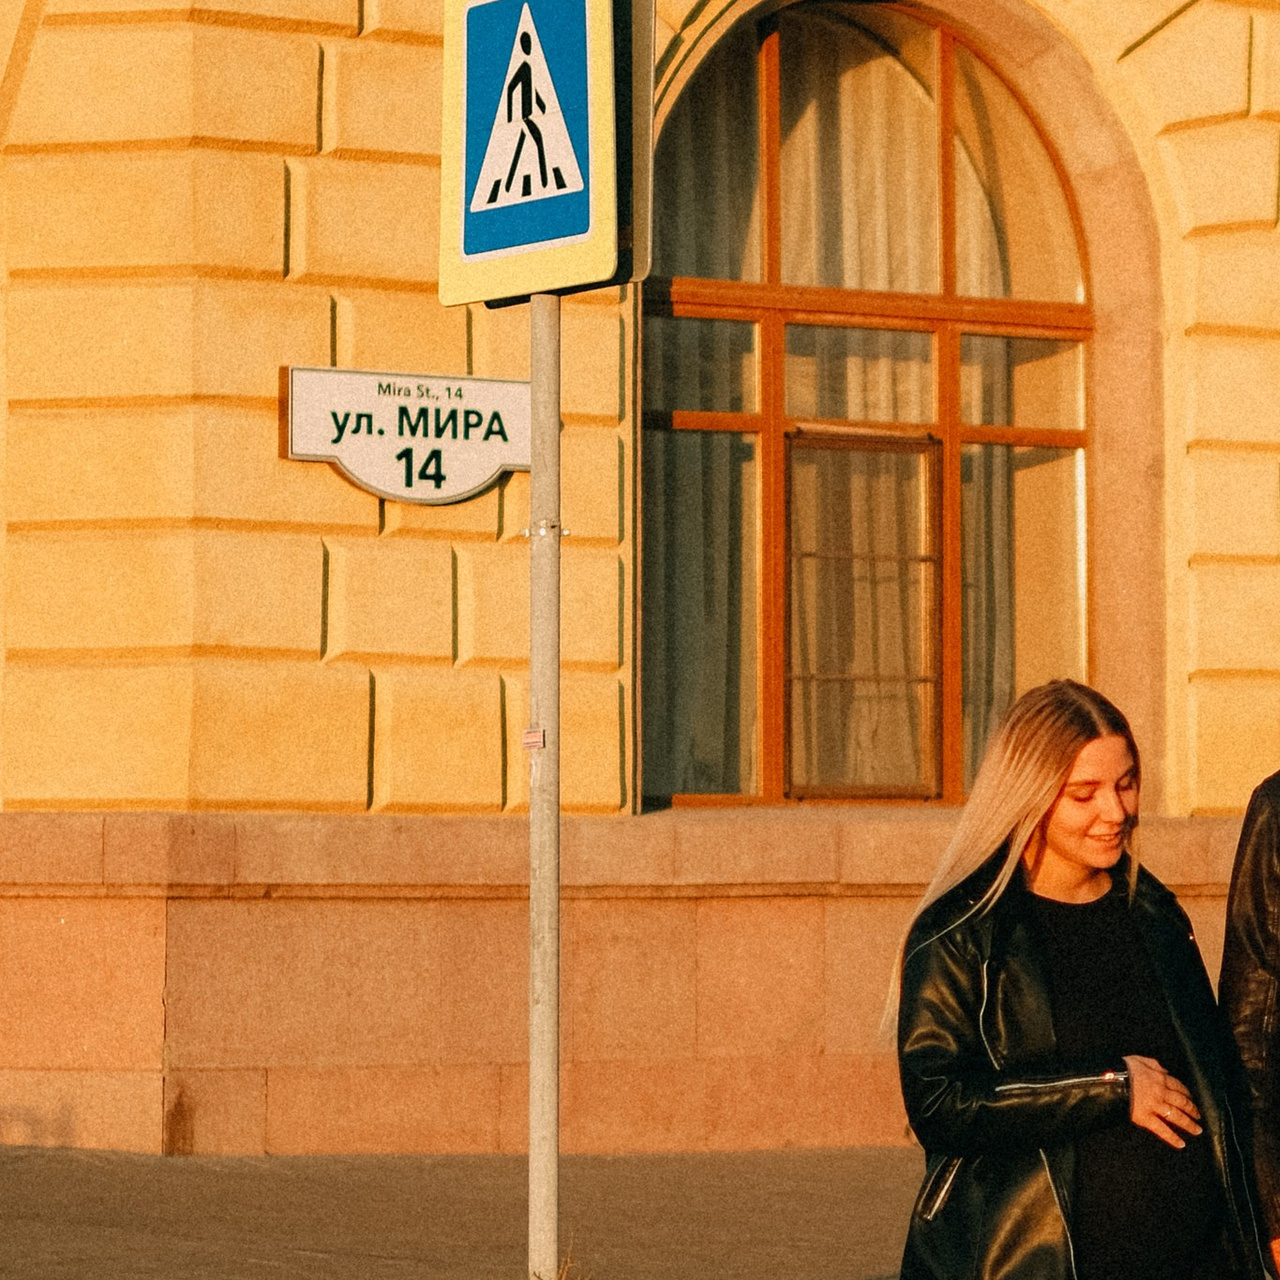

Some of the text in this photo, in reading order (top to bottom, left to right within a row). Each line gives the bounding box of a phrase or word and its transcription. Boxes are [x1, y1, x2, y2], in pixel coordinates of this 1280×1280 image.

[377, 382, 463, 400] Mira St., 14
[331, 406, 508, 444] ул. МИРА
[395, 447, 446, 489] 14
